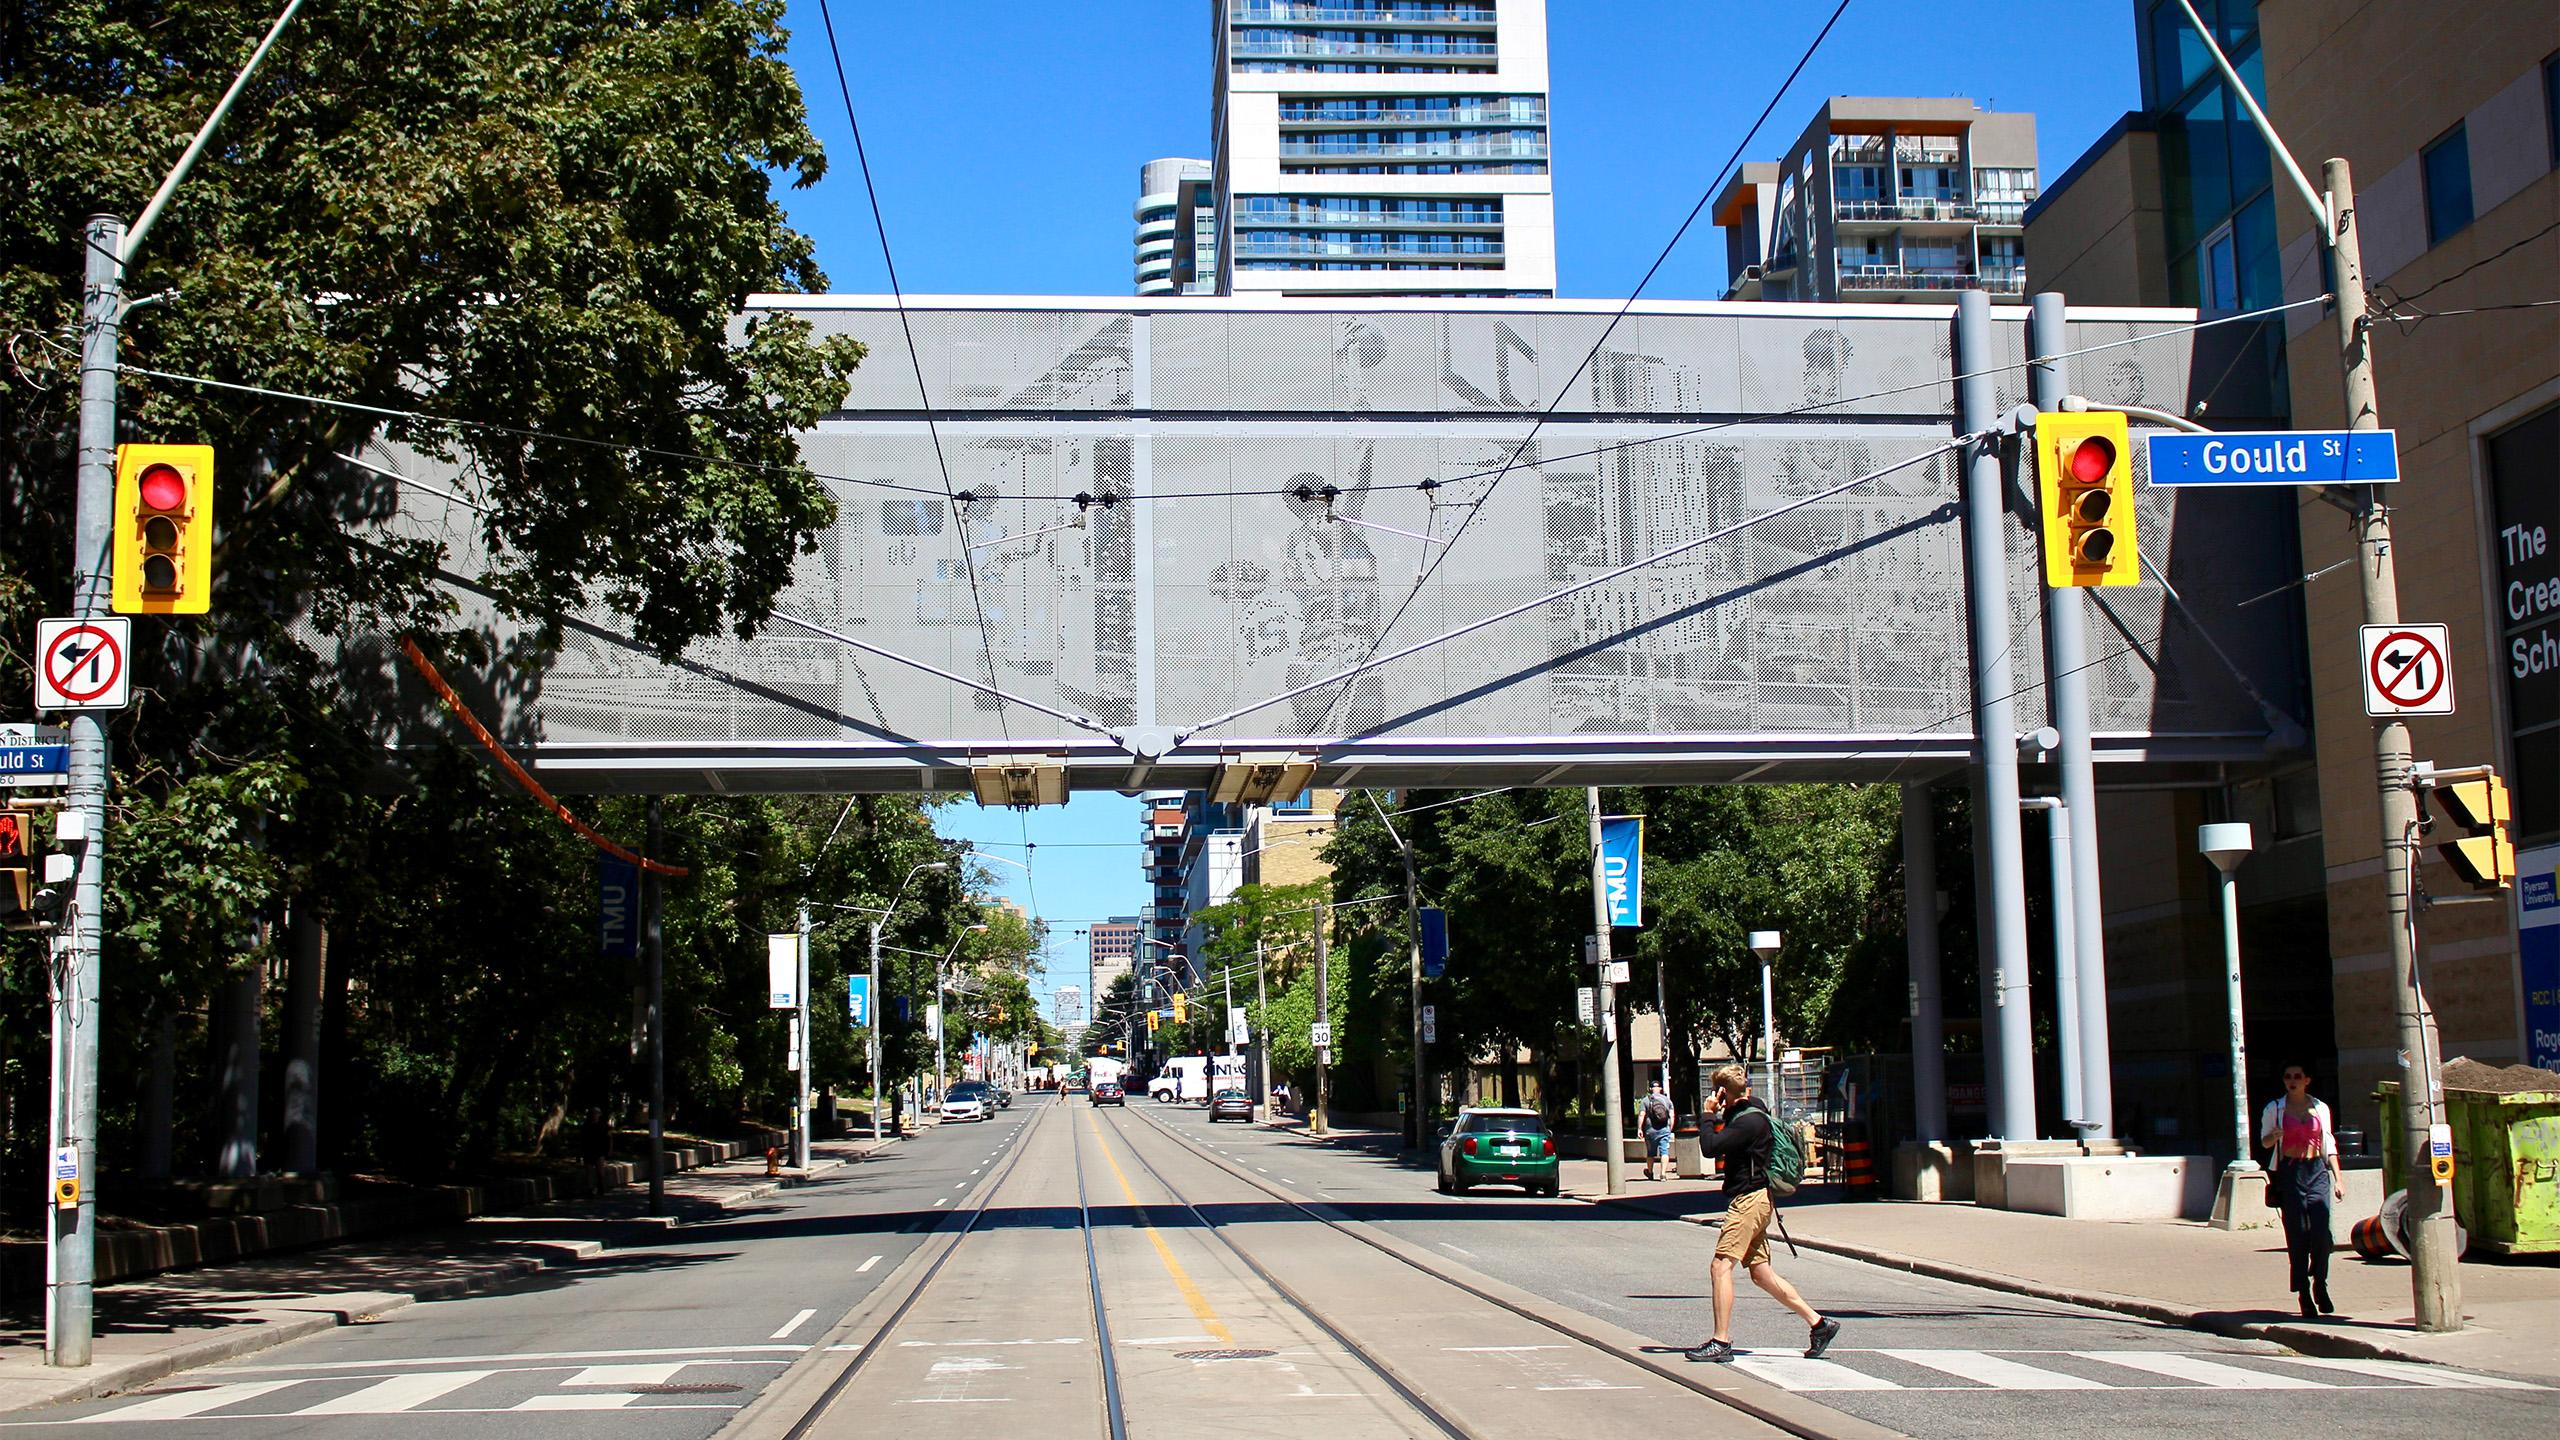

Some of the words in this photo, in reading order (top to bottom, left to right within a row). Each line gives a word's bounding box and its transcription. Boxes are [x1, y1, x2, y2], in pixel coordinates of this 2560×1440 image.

[2203, 440, 2306, 474] Gould
[2322, 440, 2341, 456] St
[2501, 523, 2547, 566] The
[2512, 629, 2560, 679] Sch
[10, 736, 60, 746] DISTRICT
[31, 754, 44, 768] St
[1605, 856, 1629, 922] TMU
[2524, 881, 2550, 896] Ryerson
[2524, 892, 2555, 905] University
[603, 886, 626, 950] TMU
[1314, 1032, 1329, 1043] 30
